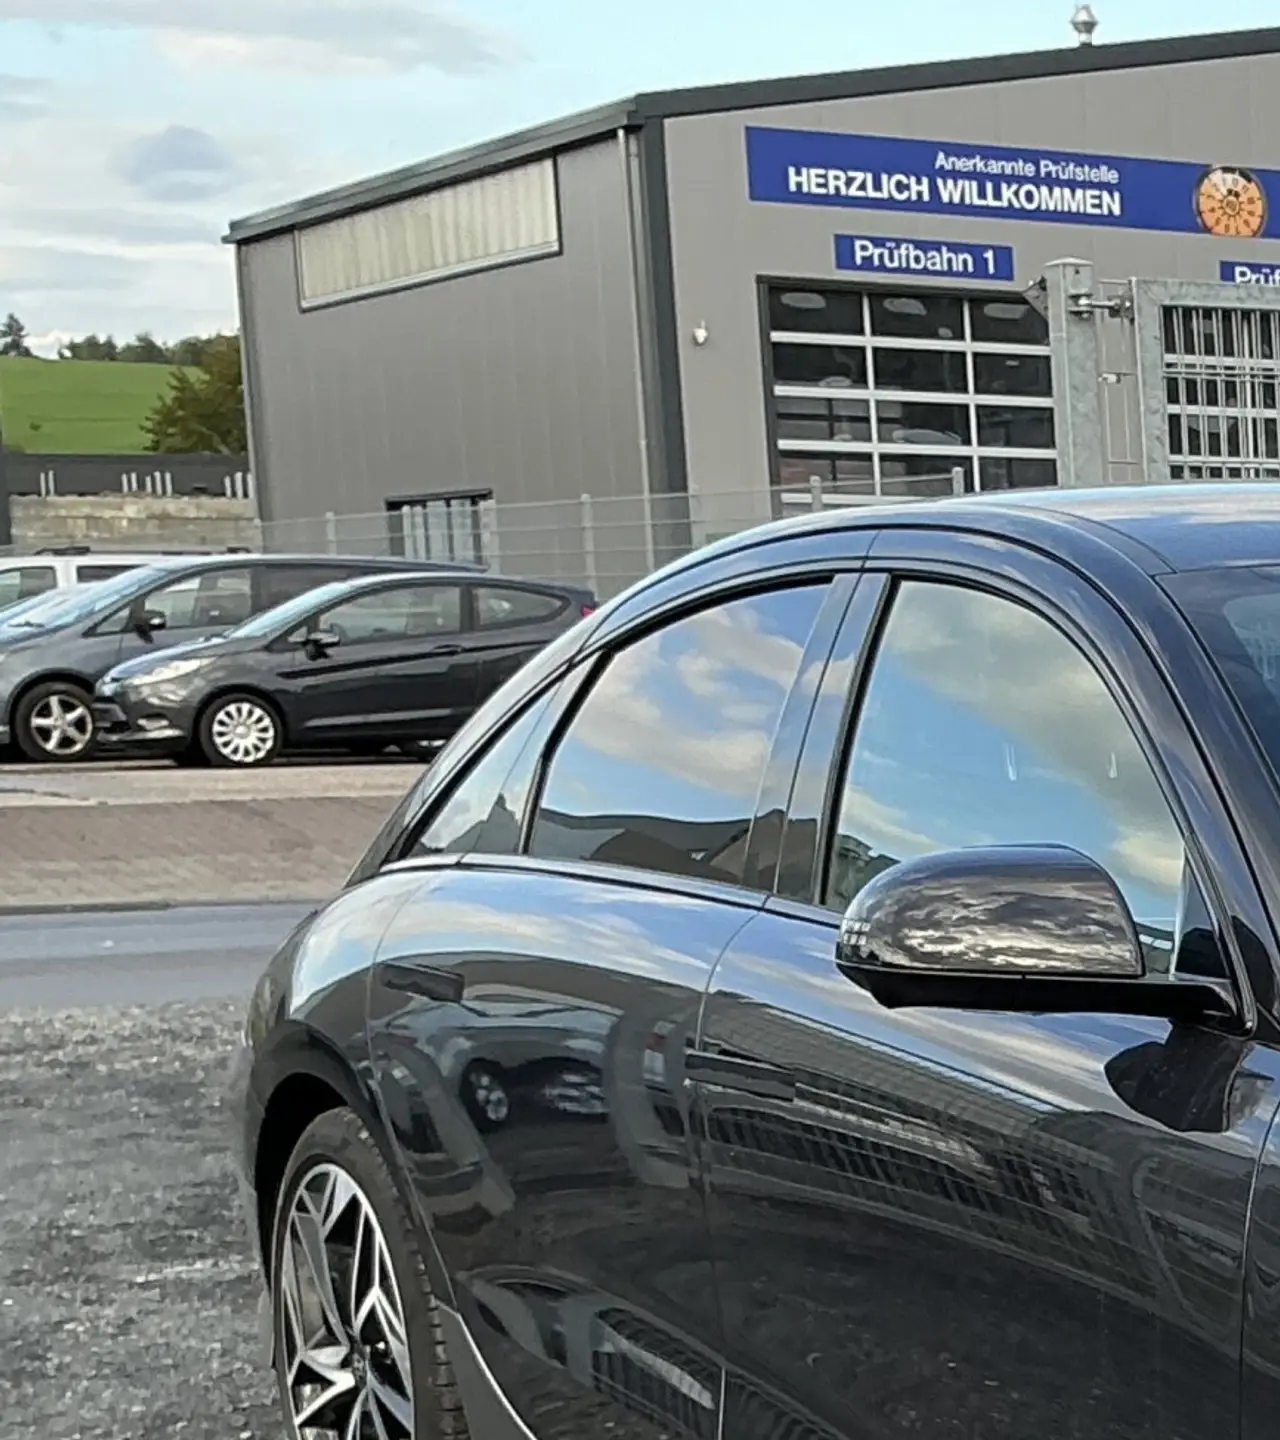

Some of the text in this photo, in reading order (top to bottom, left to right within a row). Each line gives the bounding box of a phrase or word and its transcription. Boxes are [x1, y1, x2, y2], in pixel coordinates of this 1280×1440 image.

[935, 150, 1120, 184] Anerkannte Prüfstelle
[788, 166, 1122, 217] HERZLICH WILLKOMMEN
[853, 238, 996, 275] Prüfbahn 1
